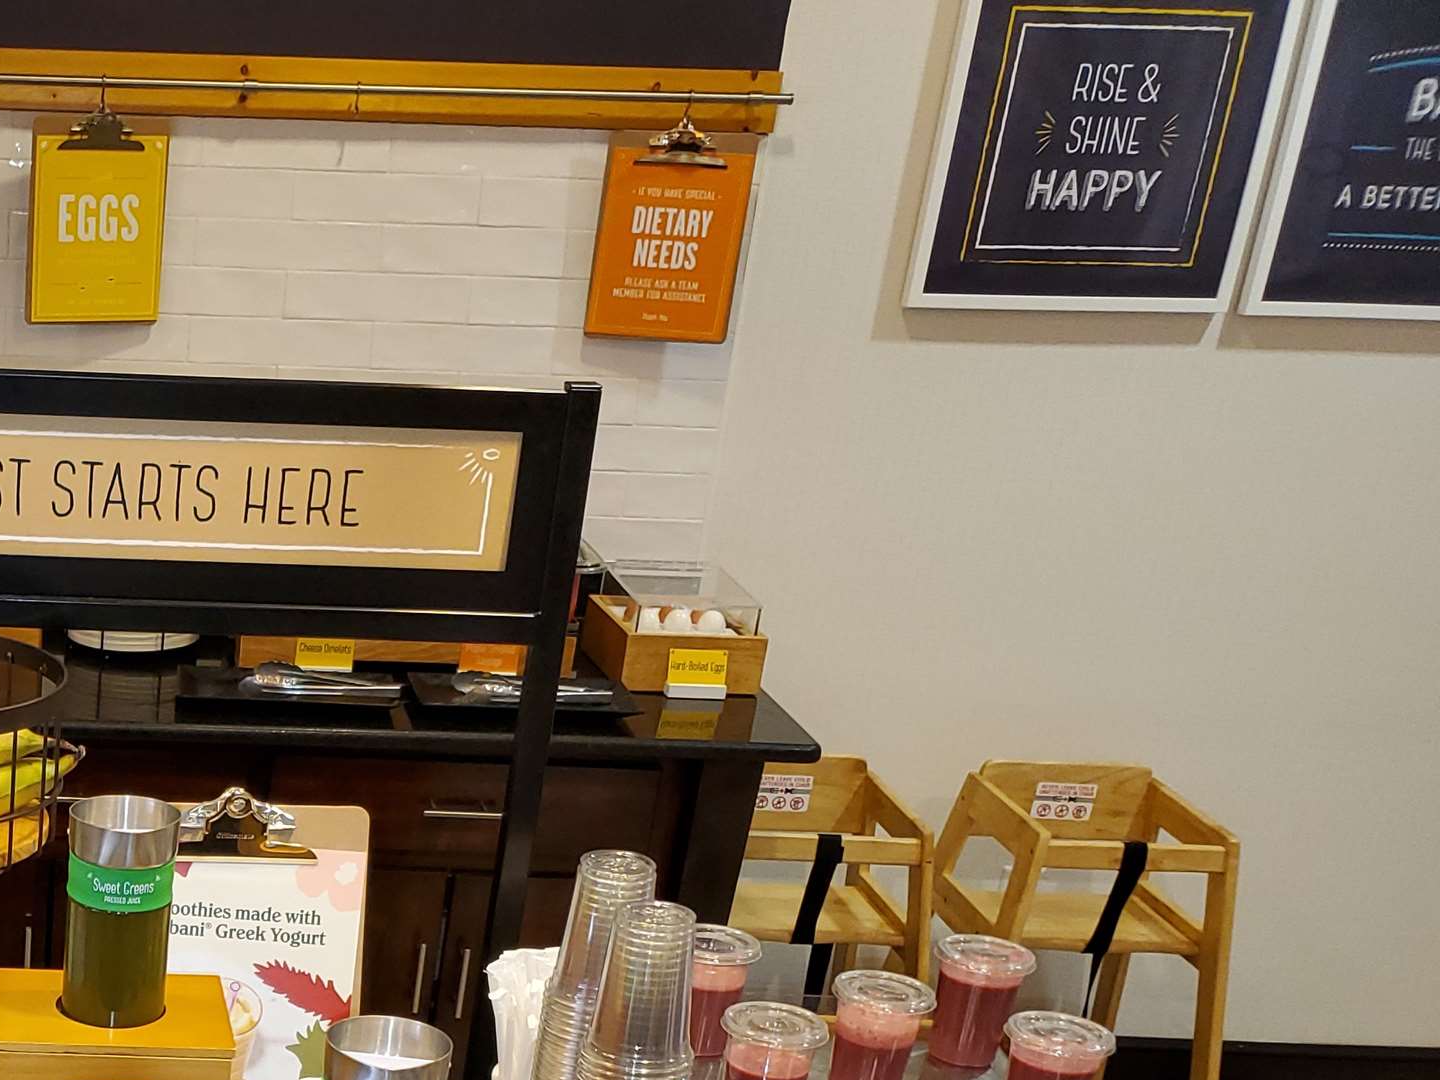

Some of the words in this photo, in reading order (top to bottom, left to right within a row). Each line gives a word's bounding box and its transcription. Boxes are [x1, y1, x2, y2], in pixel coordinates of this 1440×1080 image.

[1071, 63, 1135, 102] RISE
[1137, 63, 1161, 103] &
[1405, 77, 1440, 123] B
[1065, 115, 1147, 155] SHINE
[1405, 137, 1437, 160] THE
[1025, 168, 1163, 213] HAPPY
[1334, 183, 1352, 209] A
[58, 193, 140, 243] EGGS
[631, 205, 714, 239] DIETARY
[632, 238, 698, 271] NEEDS
[51, 458, 219, 523] STARTS
[243, 466, 365, 528] HERE
[93, 878, 121, 895] Sweet
[123, 881, 155, 896] Greens
[235, 907, 282, 922] made
[285, 911, 321, 926] with
[215, 923, 266, 941] Greek
[270, 928, 326, 948] Yogurt
